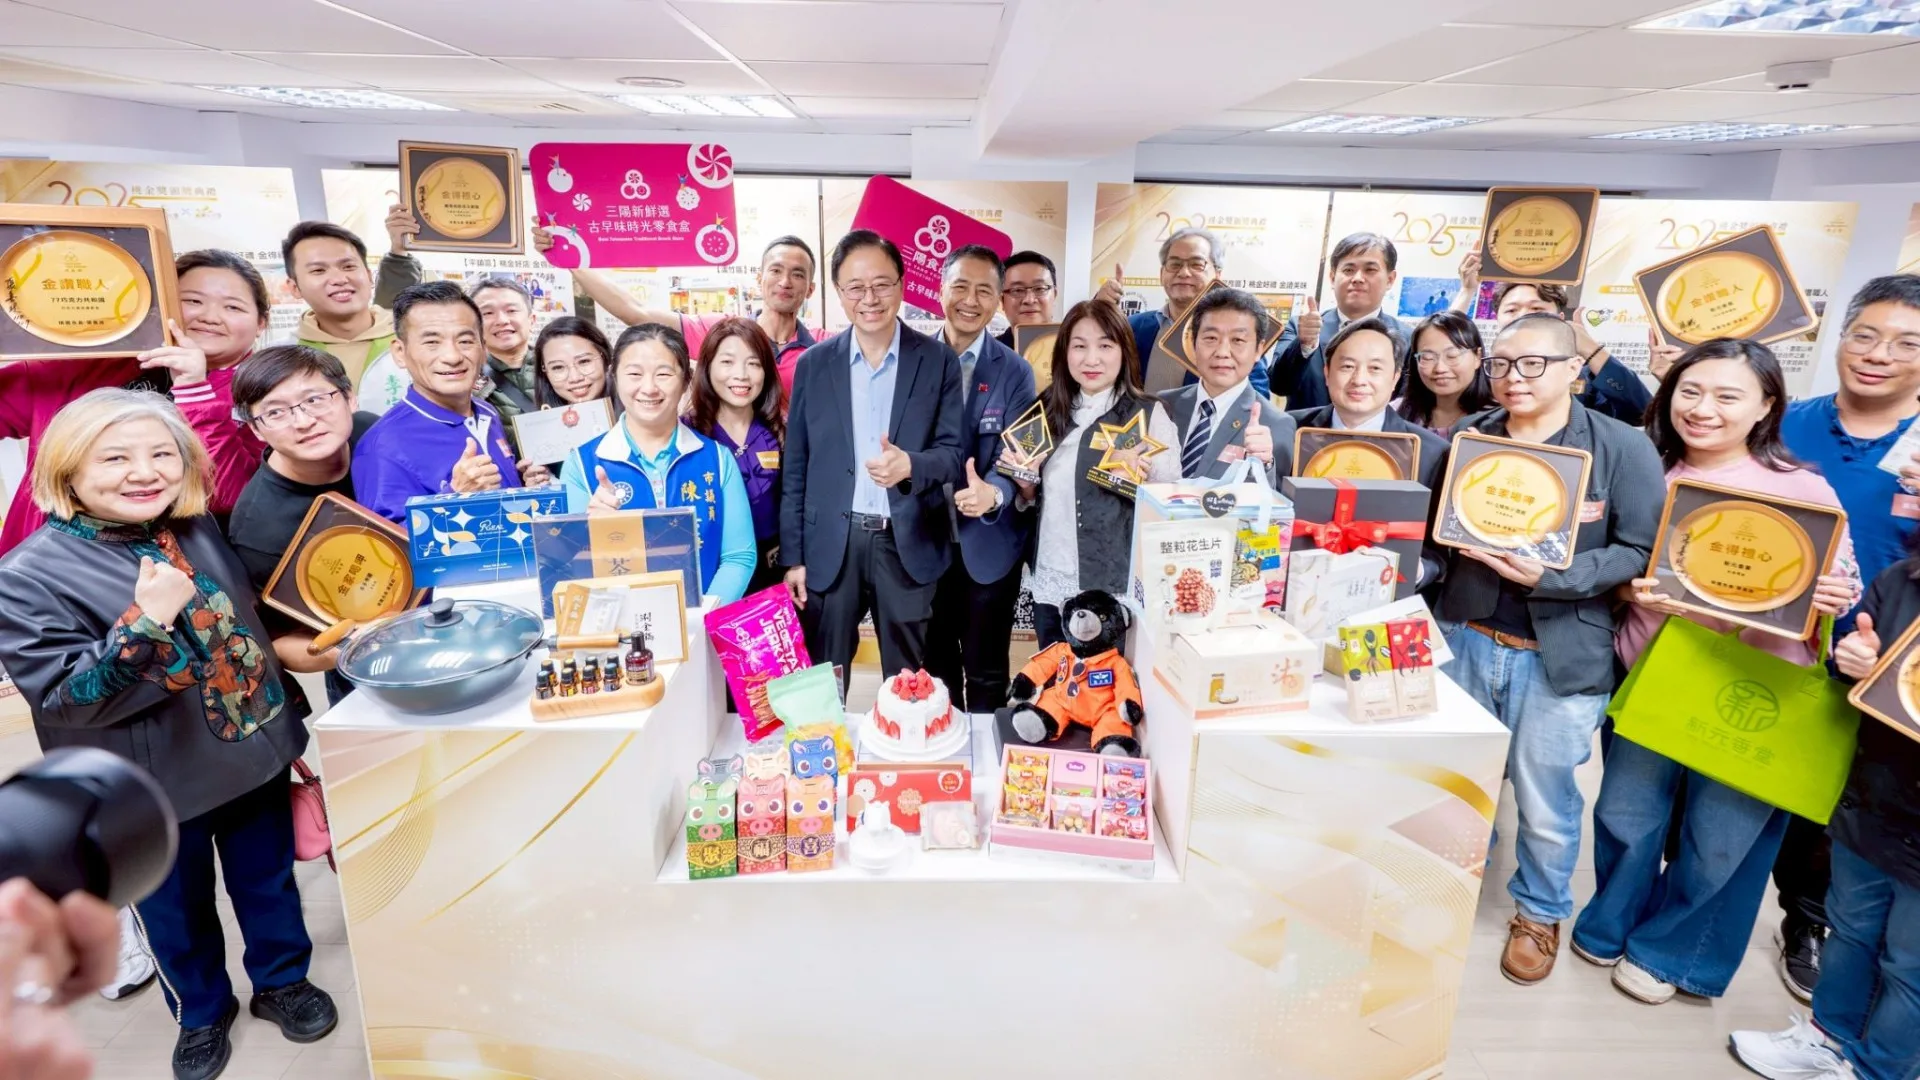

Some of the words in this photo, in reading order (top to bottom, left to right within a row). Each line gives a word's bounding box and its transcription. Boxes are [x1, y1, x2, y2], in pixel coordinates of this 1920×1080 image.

[605, 205, 670, 218] 三陽新鮮選
[587, 220, 691, 234] 古早味時光零食盒
[1393, 211, 1457, 256] 2025
[703, 470, 716, 521] 市議員
[1159, 538, 1223, 555] 整粒花生片
[1709, 541, 1773, 563] 金得禮心
[759, 618, 786, 665] JERKY
